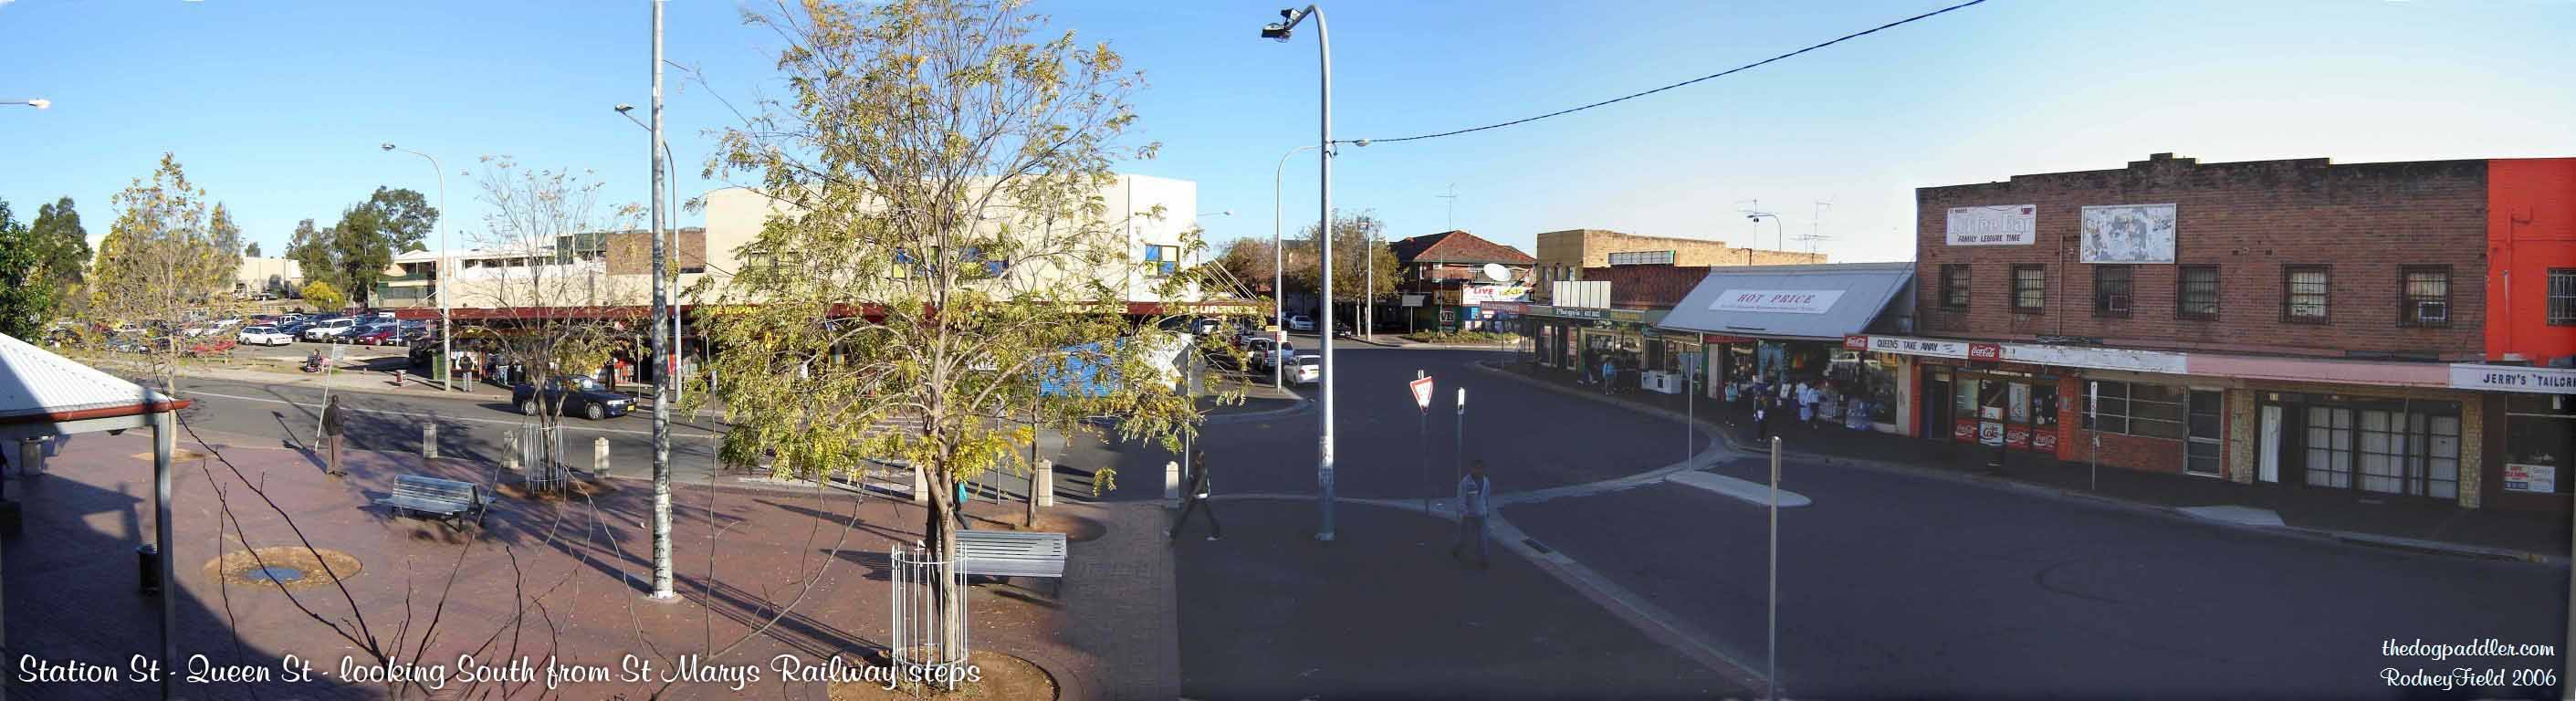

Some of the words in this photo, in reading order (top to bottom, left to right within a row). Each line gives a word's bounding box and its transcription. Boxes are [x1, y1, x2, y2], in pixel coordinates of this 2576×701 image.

[1737, 294, 1764, 303] HOT
[1771, 294, 1816, 304] PRICE
[1877, 340, 1899, 349] QUEENS
[1903, 340, 1918, 350] TAKE
[1921, 342, 1938, 351] AWAY
[2483, 373, 2527, 385] JERRY'S
